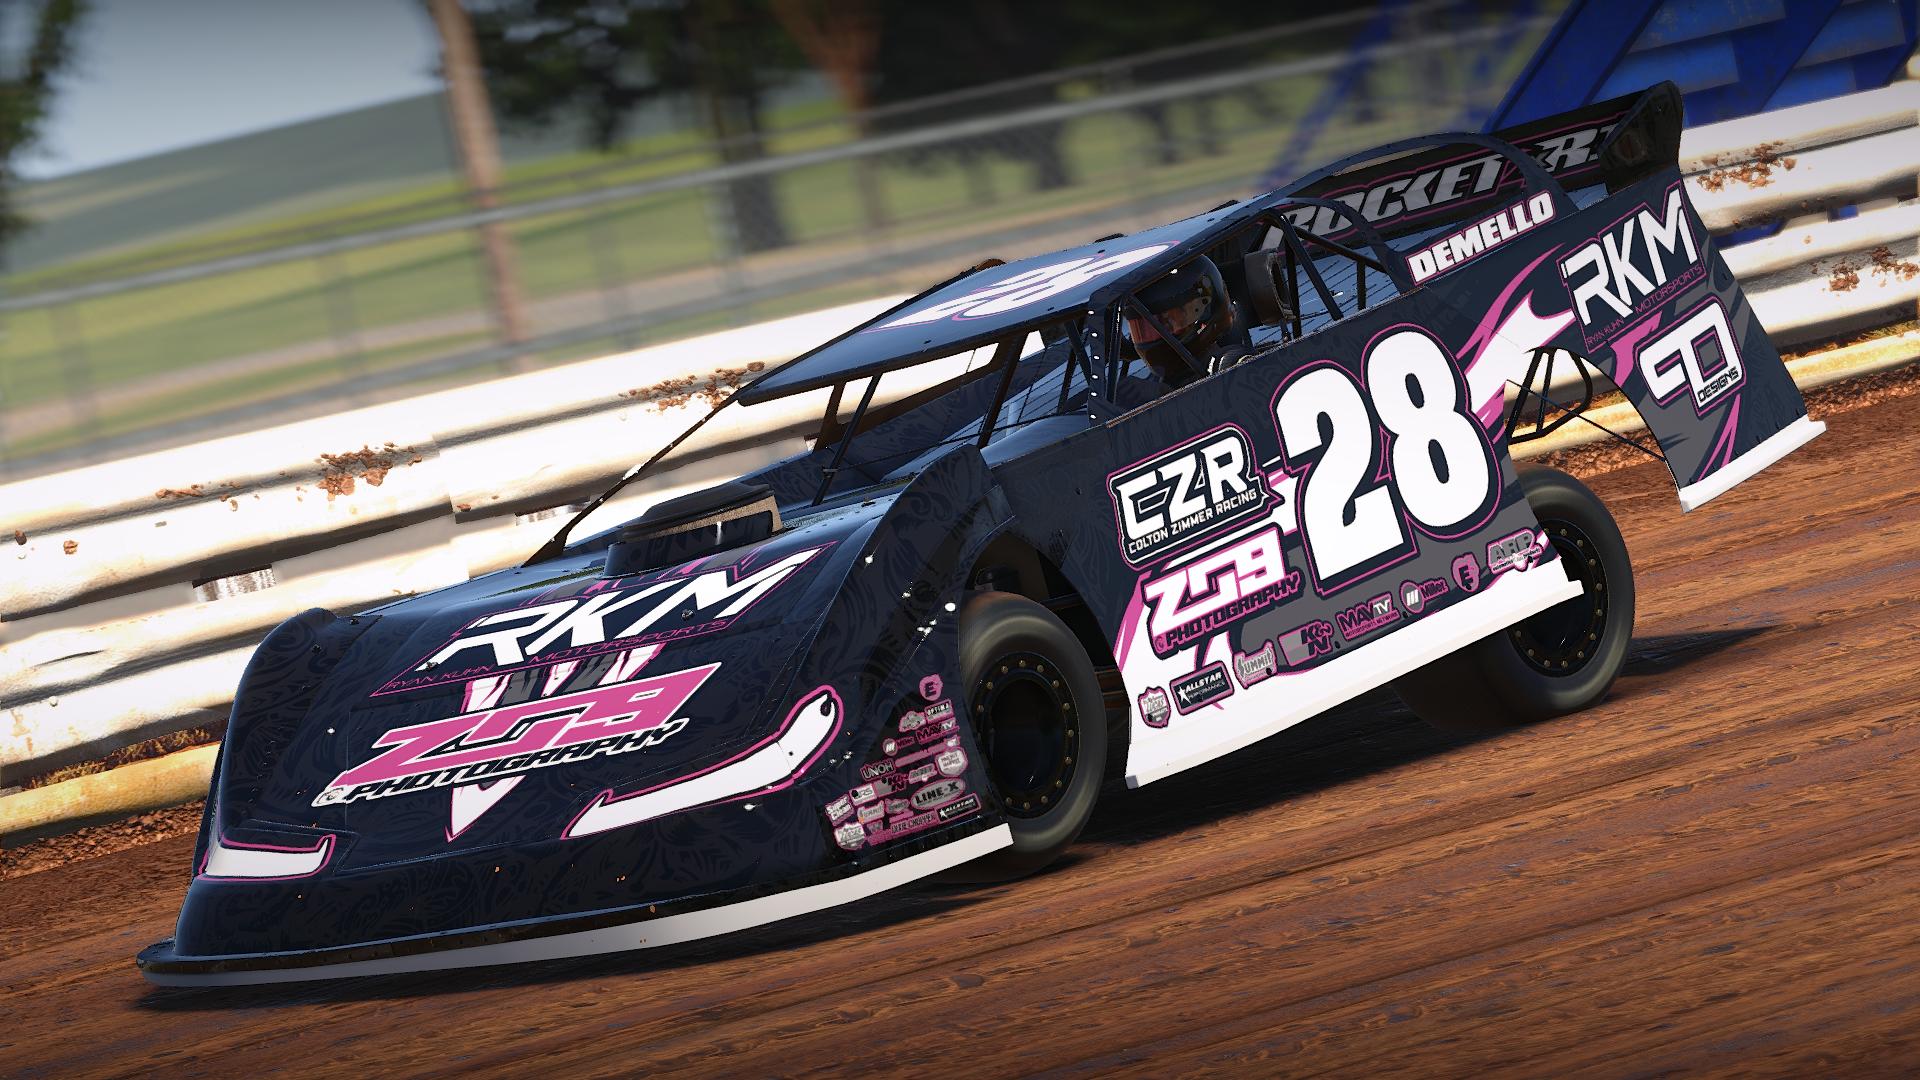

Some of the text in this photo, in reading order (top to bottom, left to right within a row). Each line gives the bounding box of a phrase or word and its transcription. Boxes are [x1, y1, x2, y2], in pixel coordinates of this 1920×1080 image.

[1408, 192, 1554, 283] DEMELLO
[1561, 188, 1698, 326] RKM
[1635, 266, 1702, 314] MOTORSPORTS
[1697, 366, 1739, 402] DESIGNS
[1276, 331, 1490, 581] 28
[1128, 488, 1257, 553] COLTON ZIMMER RACING
[1489, 532, 1533, 565] ARP
[415, 548, 822, 671] RKM
[1164, 572, 1300, 647] PHOTOGRAPHY
[384, 674, 438, 690] RYAN
[529, 619, 729, 664] MOTORSPORTS
[1185, 671, 1222, 693] ALLSTAR
[345, 718, 689, 802] PHOTOGRAPHY
[915, 782, 959, 804] LINE-X
